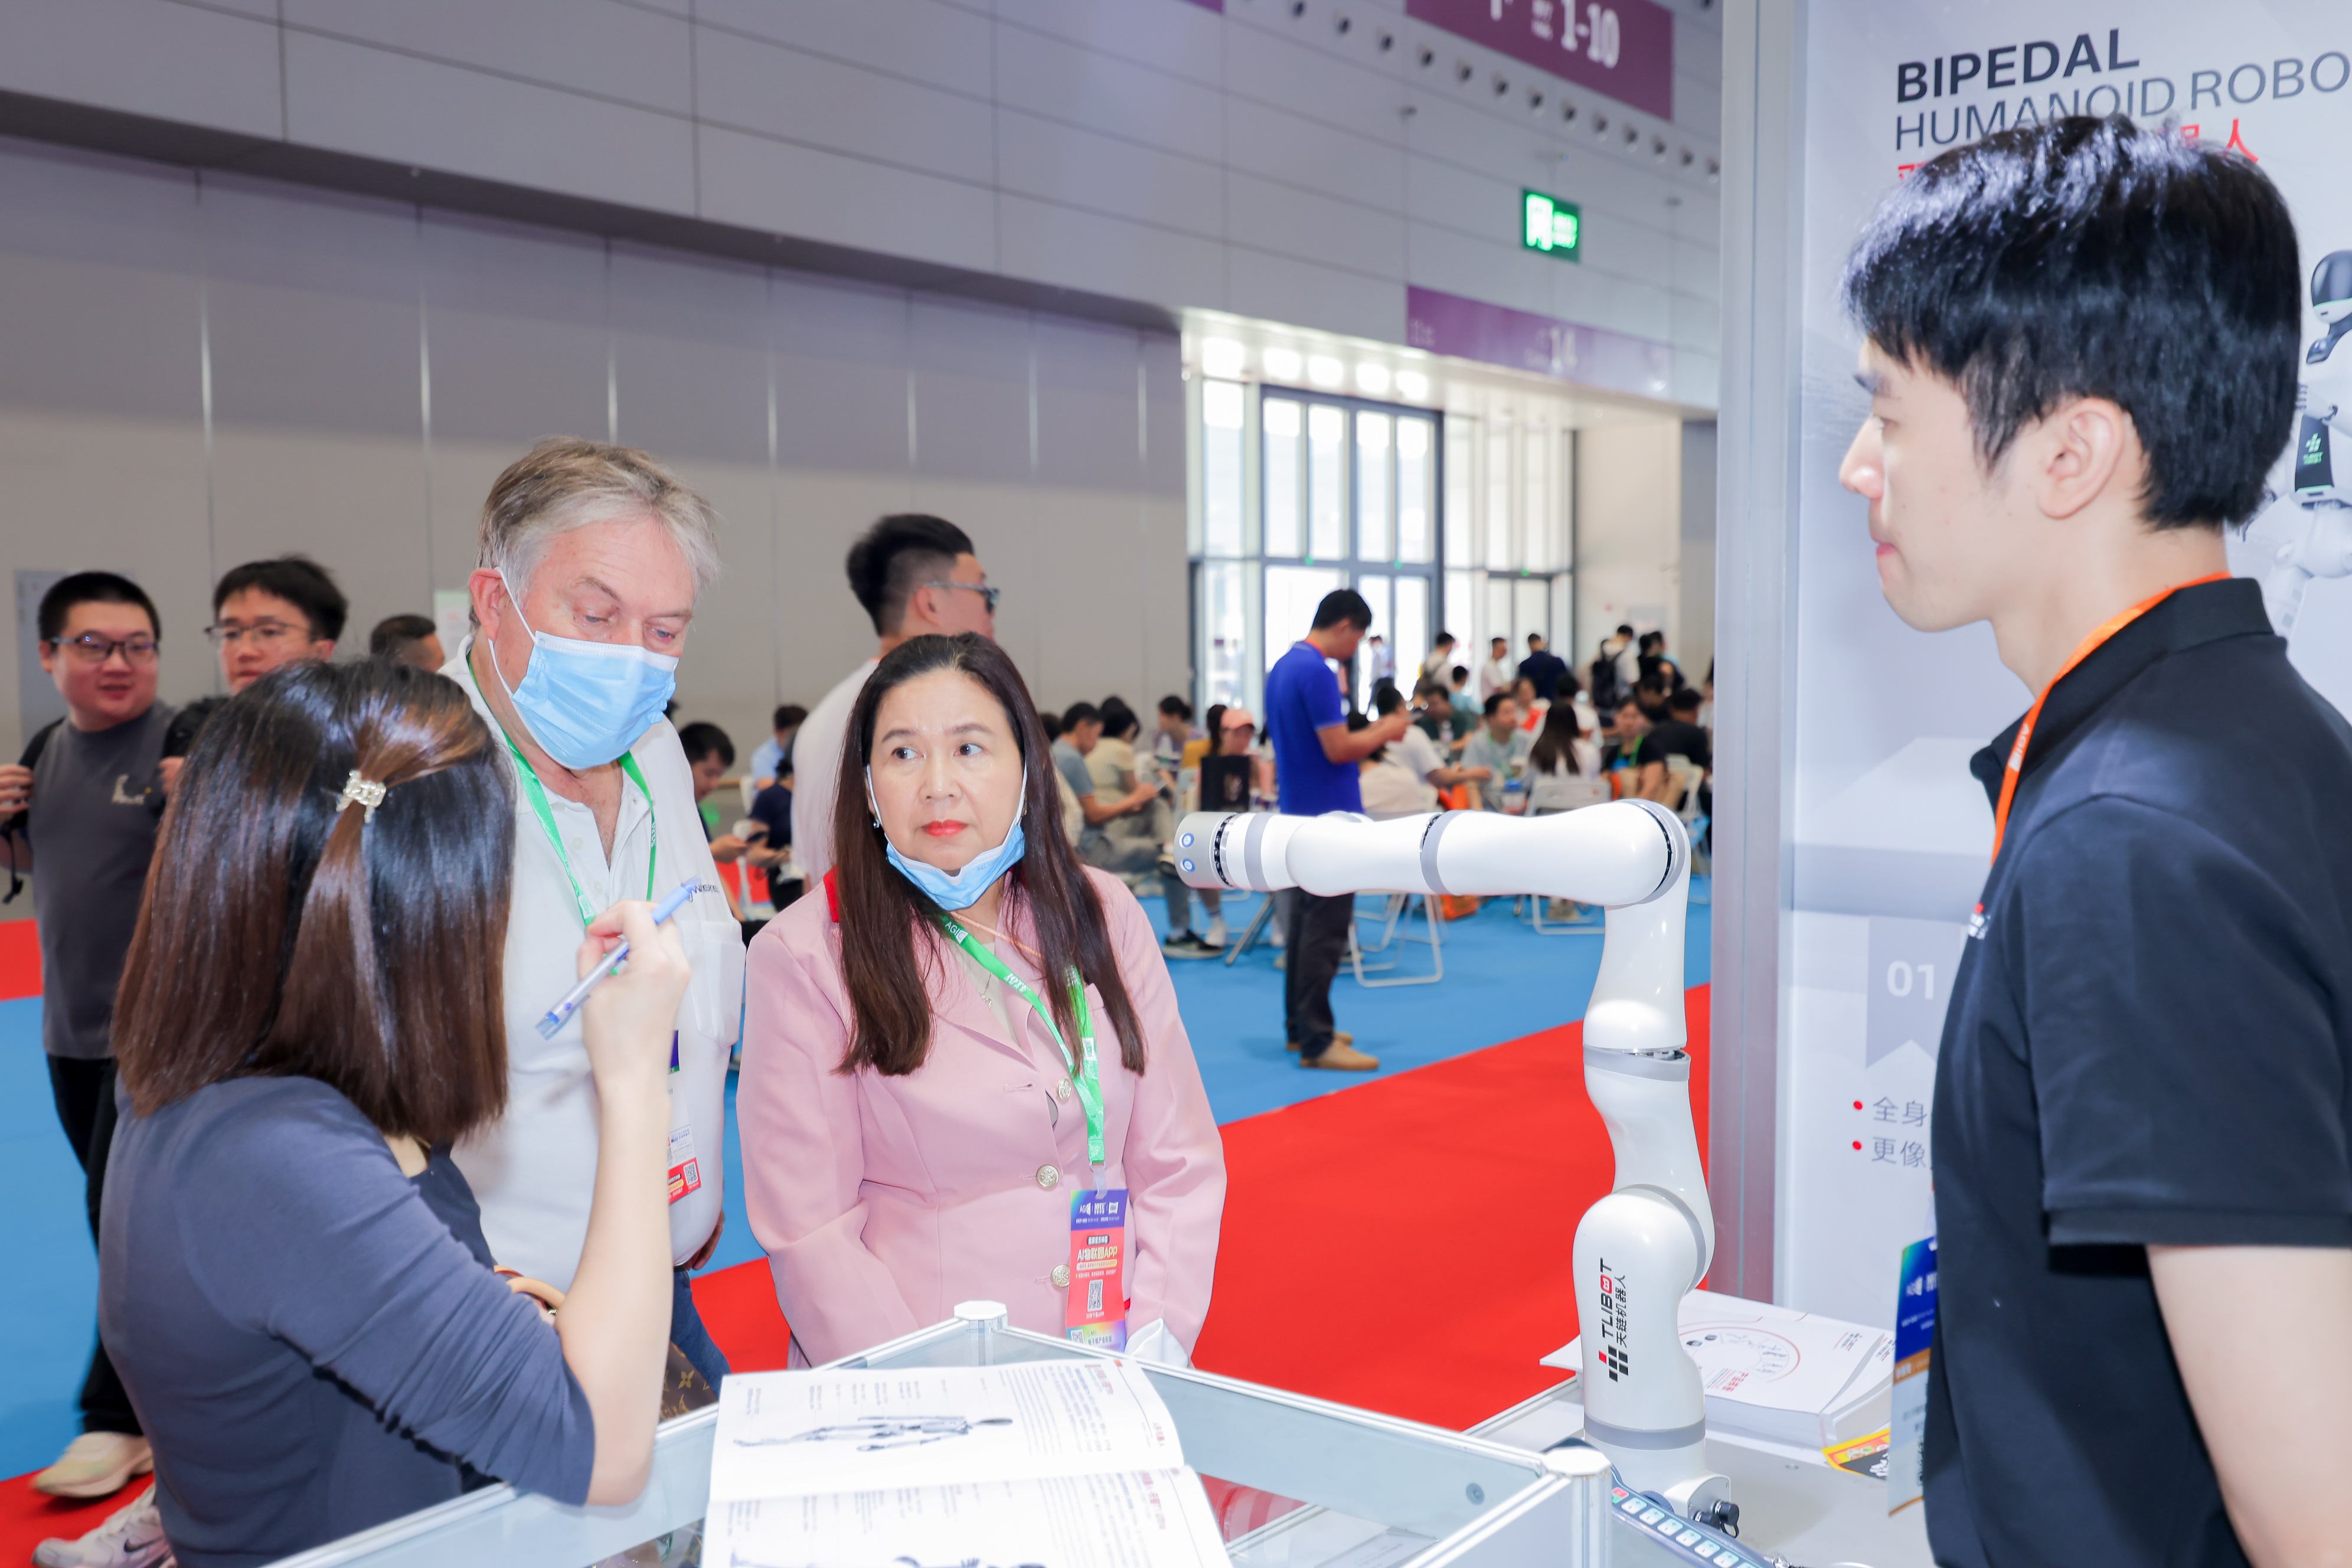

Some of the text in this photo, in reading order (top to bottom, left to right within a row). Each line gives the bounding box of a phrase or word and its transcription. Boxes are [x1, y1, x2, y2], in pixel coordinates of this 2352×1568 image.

[1897, 28, 2140, 103] BIPEDAL
[1896, 77, 2176, 151] HUMANOID
[2191, 51, 2351, 110] ROBO
[1887, 961, 1935, 1000] 01
[1873, 1096, 1928, 1127] 全身
[1871, 1136, 1927, 1169] 更像
[1614, 1274, 1628, 1348] 天链机器人
